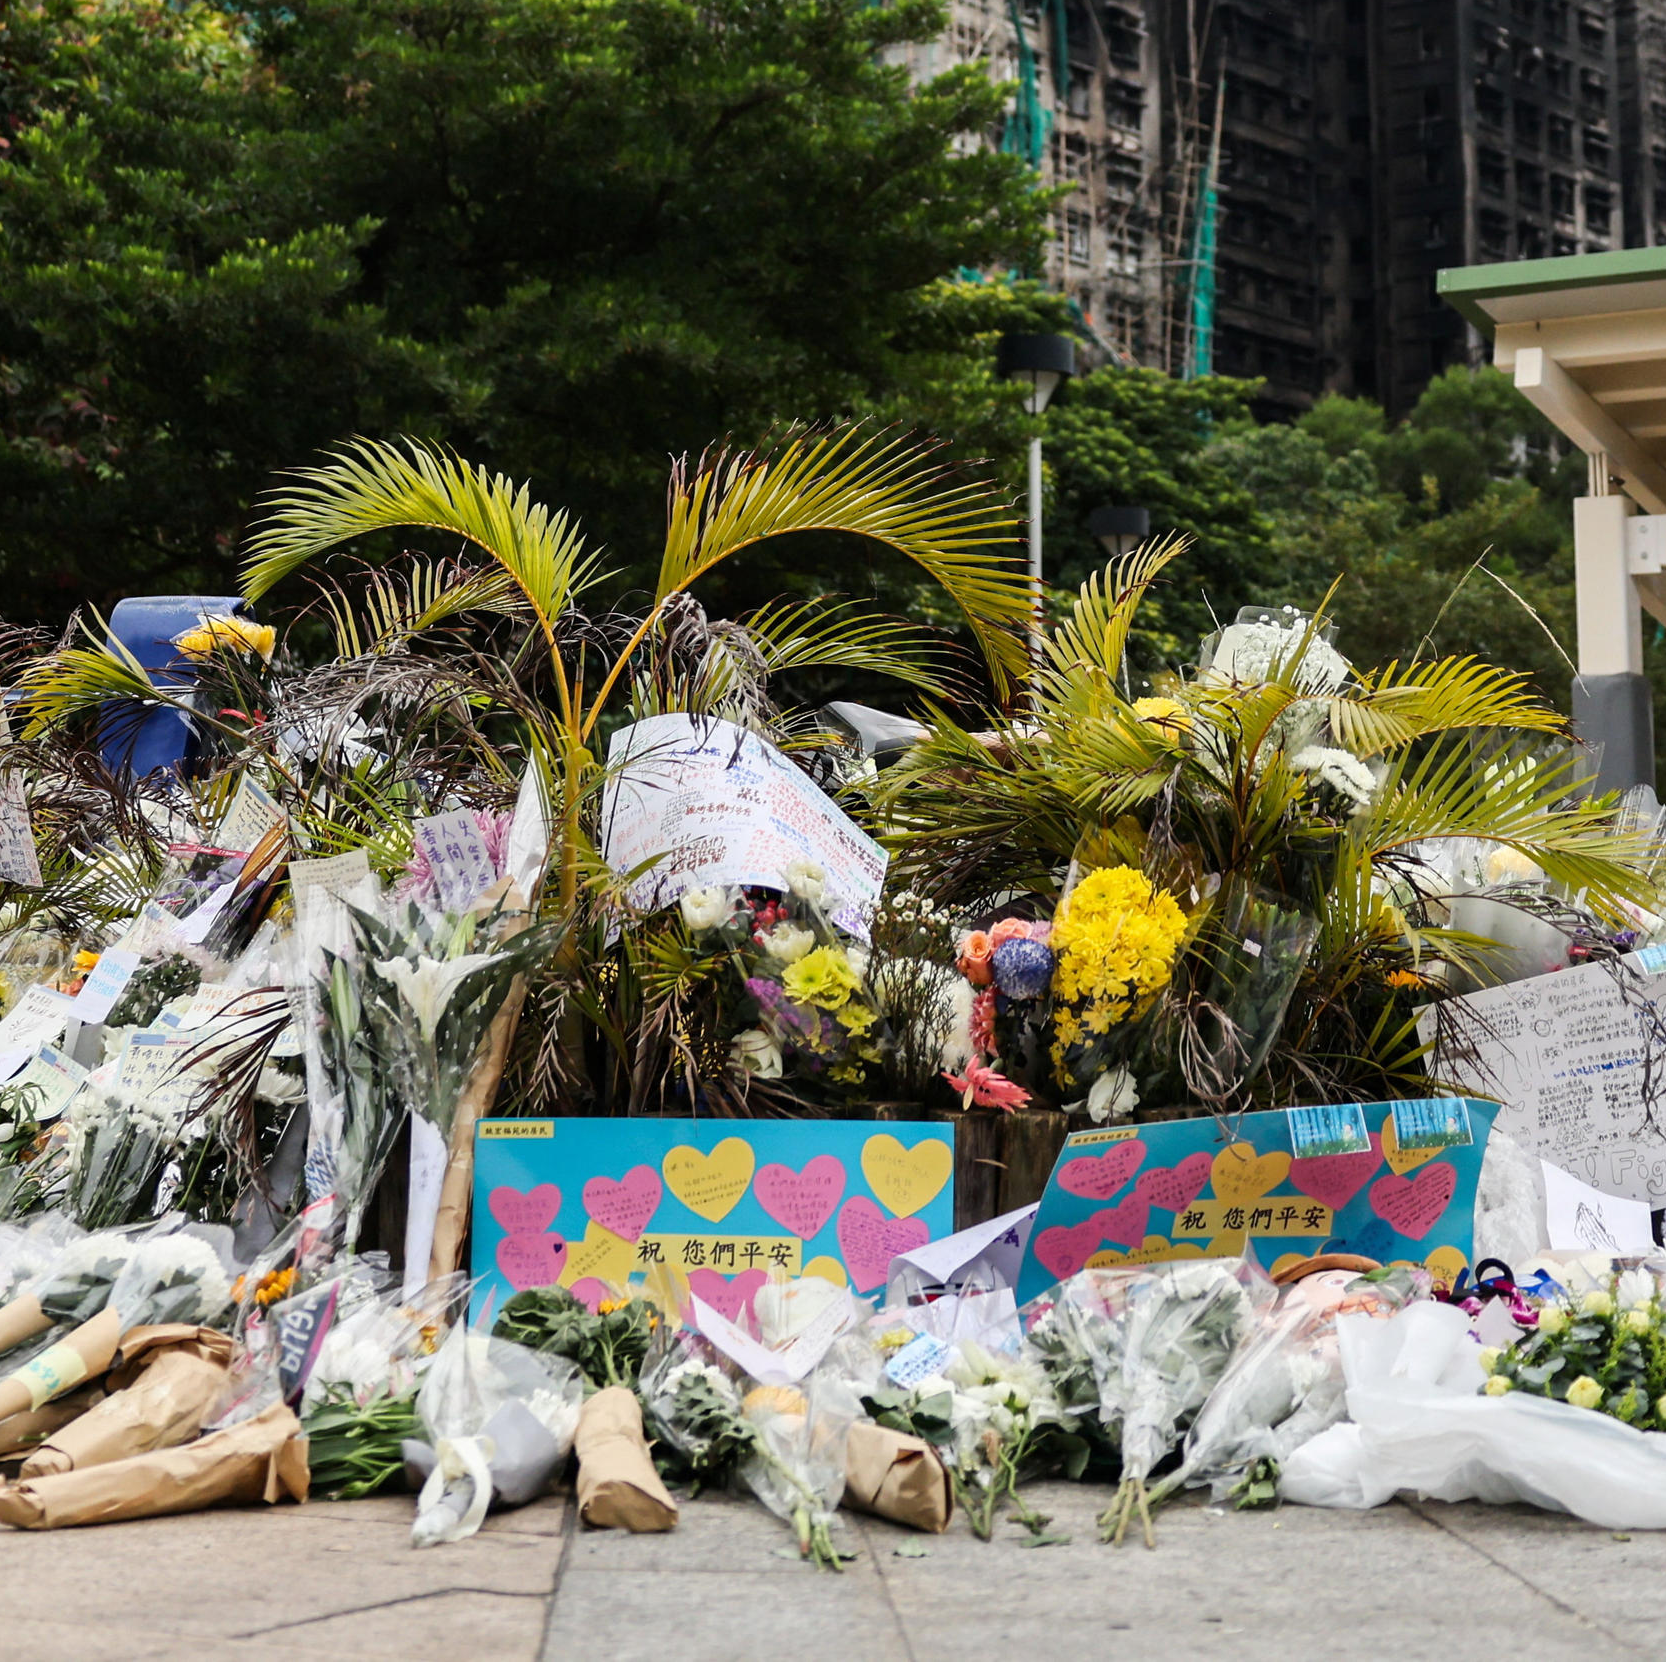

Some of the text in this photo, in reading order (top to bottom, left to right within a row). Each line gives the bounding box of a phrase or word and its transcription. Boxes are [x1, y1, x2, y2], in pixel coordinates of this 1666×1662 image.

[1181, 1206, 1326, 1231] 祝 您們平安
[637, 1239, 794, 1268] 祝 您們平安
